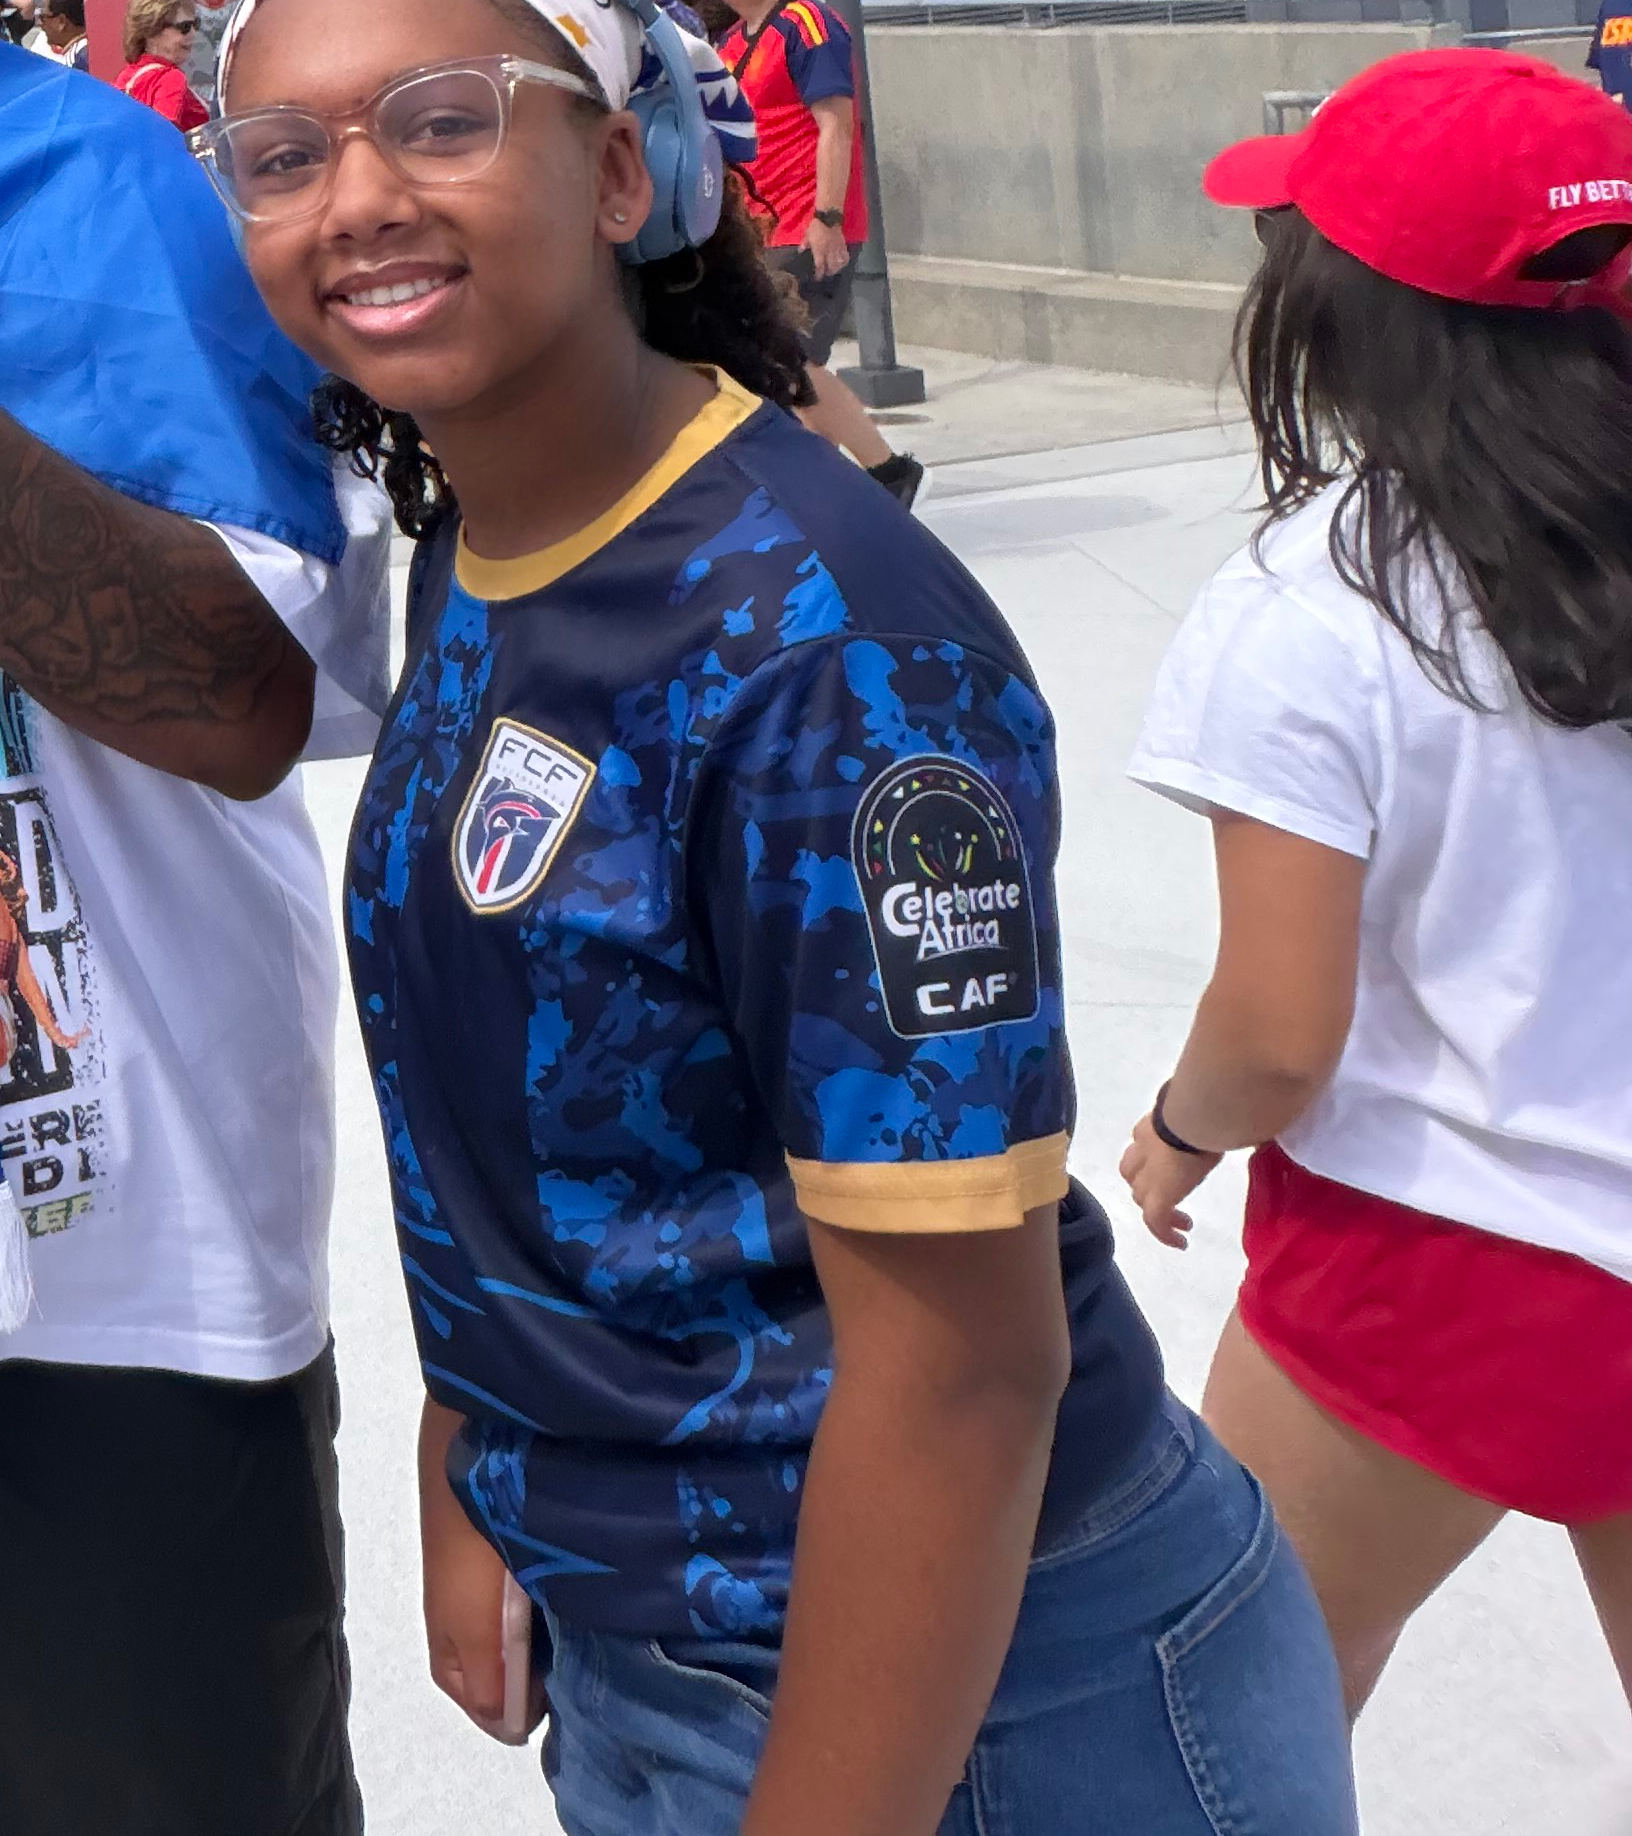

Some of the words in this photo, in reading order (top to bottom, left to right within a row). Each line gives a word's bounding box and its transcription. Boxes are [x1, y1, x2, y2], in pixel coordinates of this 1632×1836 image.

[1548, 182, 1582, 211] FLY
[498, 737, 578, 783] FCF
[881, 878, 1021, 938] Celebrate
[916, 913, 1000, 963] Africa
[916, 972, 1009, 1016] CAF
